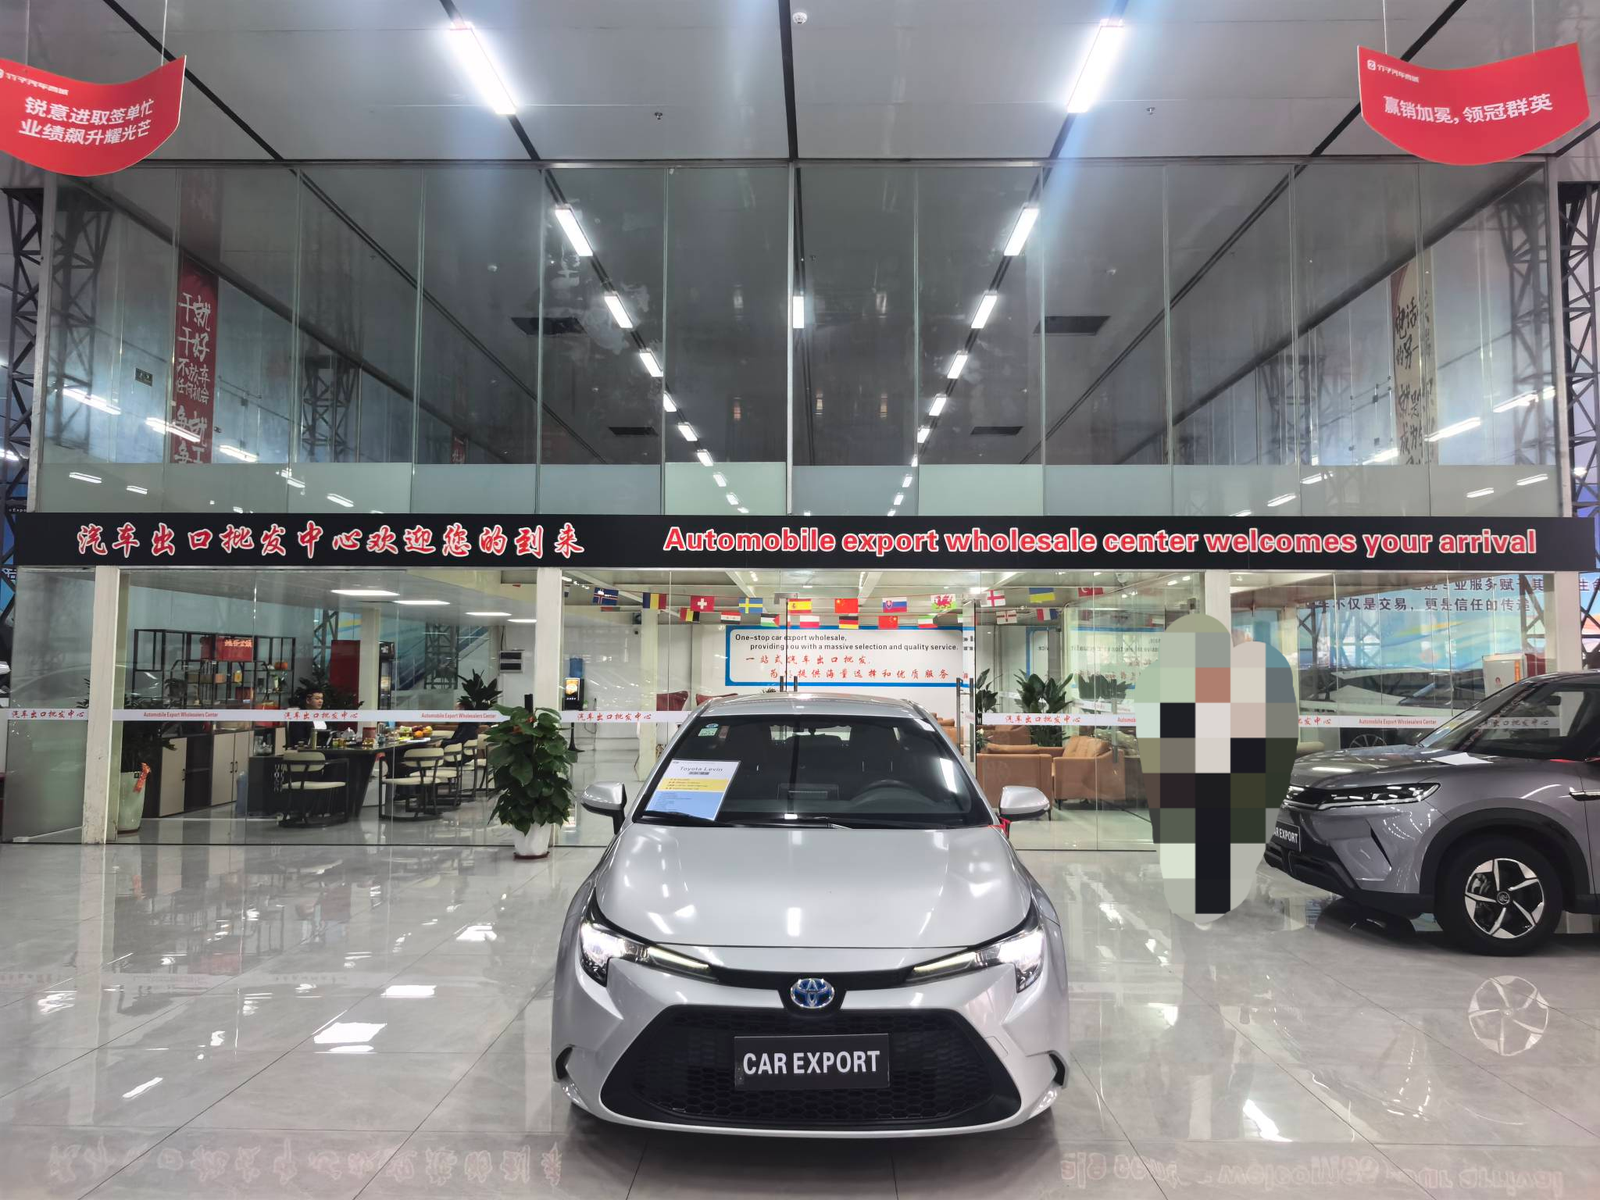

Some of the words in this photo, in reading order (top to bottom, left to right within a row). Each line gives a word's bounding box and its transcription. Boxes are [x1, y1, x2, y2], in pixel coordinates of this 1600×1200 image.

[25, 96, 154, 126] 锐意进取签单忙
[18, 118, 152, 146] 业绩飙升耀光芒
[76, 520, 586, 558] 汽车出口批发中心欢迎您的到来
[663, 526, 836, 552] Automobile
[841, 528, 939, 557] export
[944, 527, 1097, 553] wholesale
[1102, 530, 1200, 552] center
[1203, 528, 1358, 553] welcomes
[1362, 533, 1433, 558] your
[1438, 529, 1537, 554] arrival
[735, 633, 770, 642] One-stop
[809, 633, 847, 642] wholesale,
[903, 643, 929, 651] quality
[770, 668, 949, 679] 为提供海量选择和优质服务
[11, 709, 85, 719] 汽车出口批发中心
[283, 711, 358, 720] 汽车出口批发中心
[577, 712, 652, 722] 汽车出口批发中心
[1005, 715, 1081, 724] 汽车出口批发中心
[1298, 716, 1331, 726] 发中心
[743, 1052, 787, 1075] CAR
[793, 1050, 880, 1074] EXPORT
